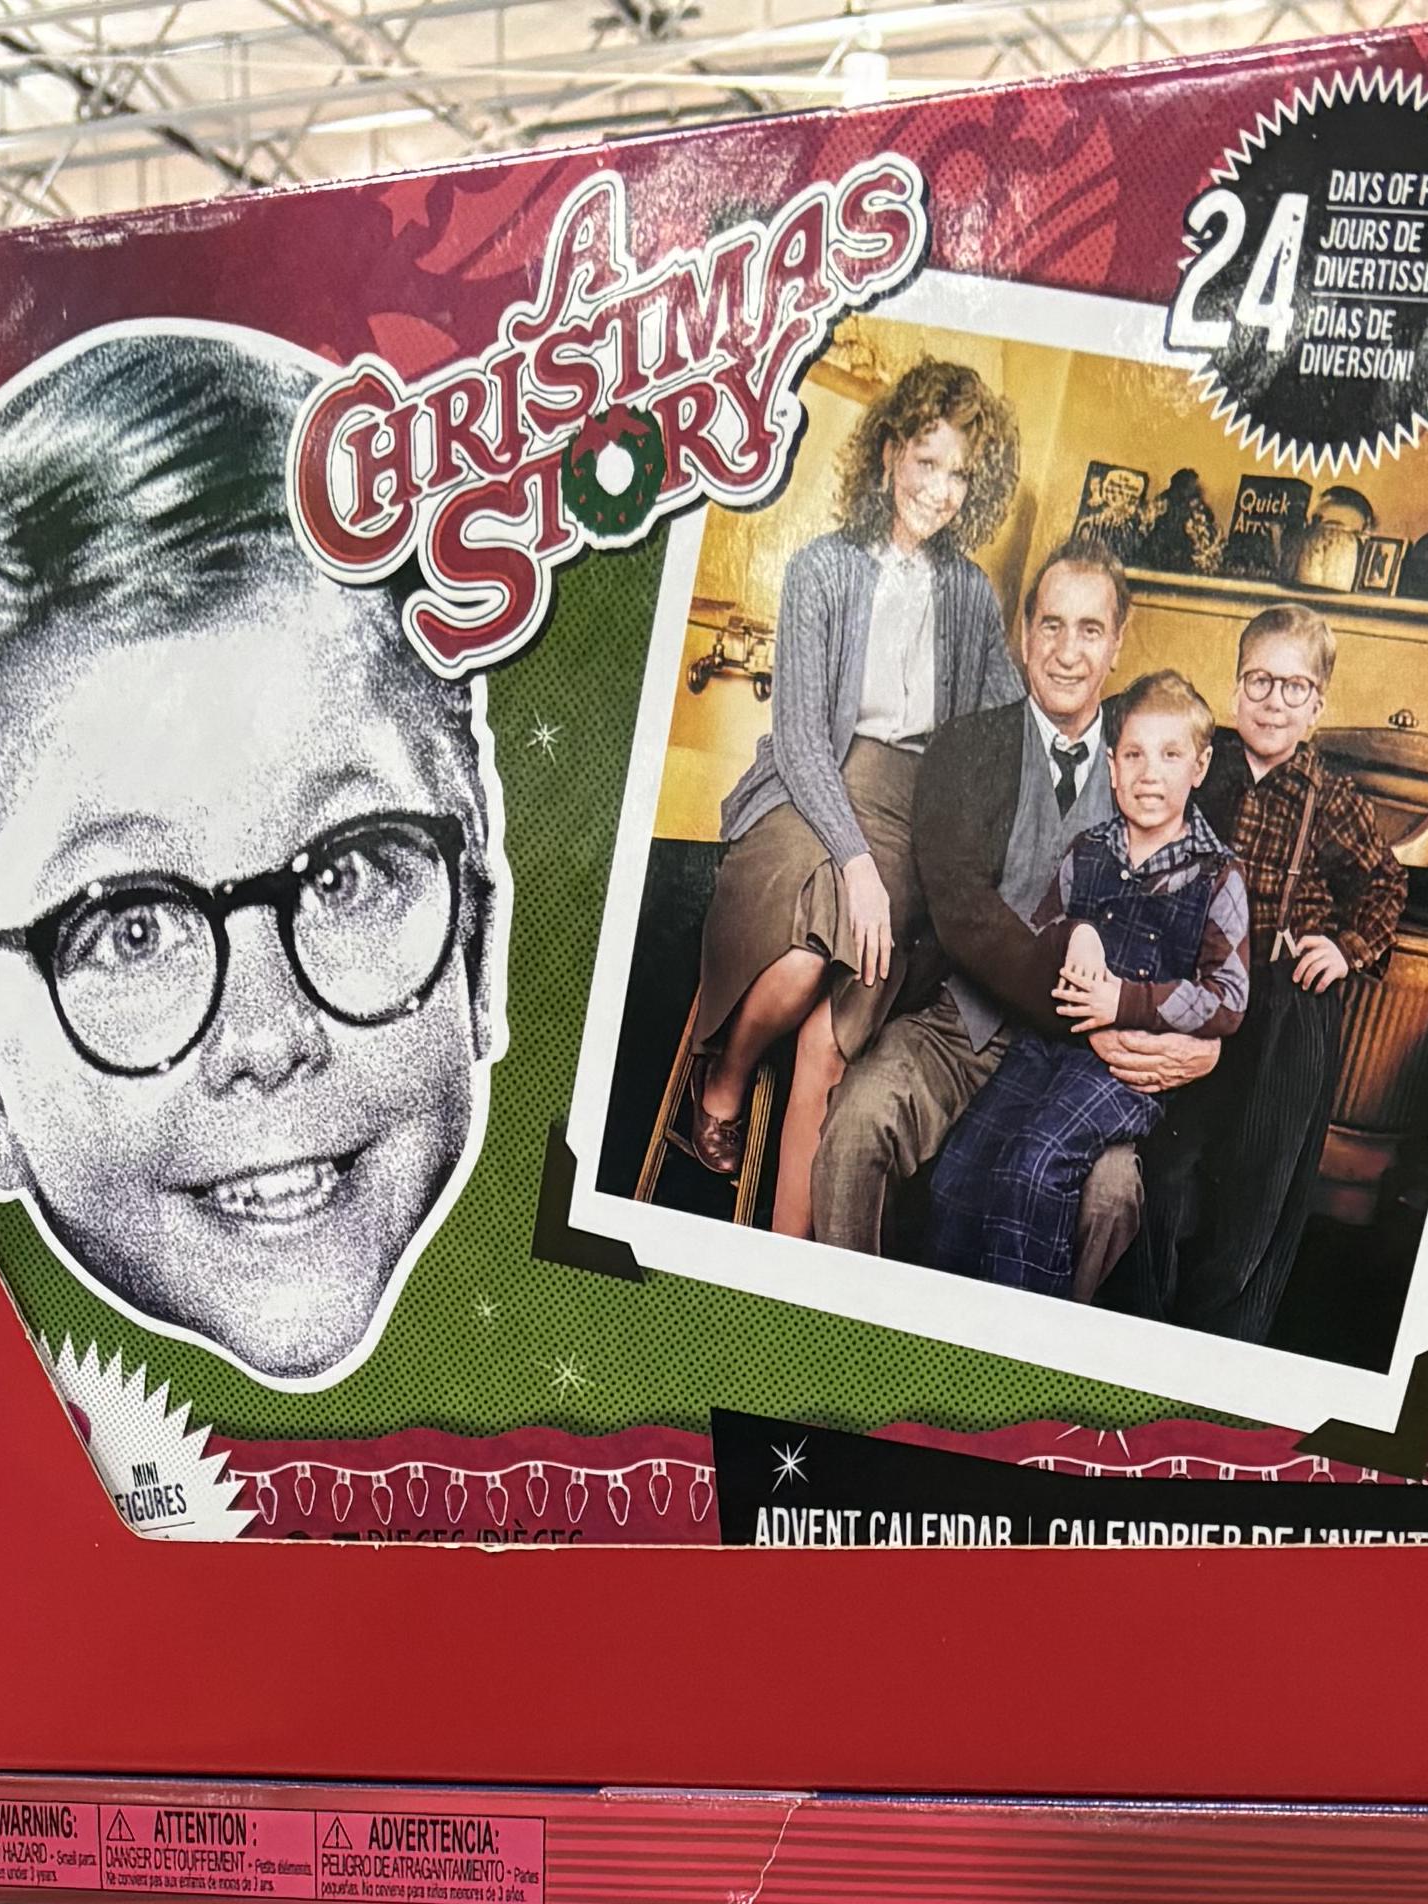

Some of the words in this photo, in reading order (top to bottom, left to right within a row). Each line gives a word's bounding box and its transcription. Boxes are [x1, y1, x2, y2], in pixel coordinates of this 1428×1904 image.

[1329, 170, 1383, 205] DAYS
[1388, 173, 1415, 206] OF
[1320, 218, 1390, 251] JOURS
[1394, 222, 1425, 253] DE
[515, 193, 627, 340] A
[1169, 189, 1308, 350] 24
[1366, 310, 1397, 341] DE
[296, 168, 910, 563] CHRISTMAS
[1299, 343, 1415, 381] DIVERSIÓN!
[416, 322, 812, 655] STORY
[132, 1461, 158, 1486] MINI
[369, 1817, 499, 1853] ADVERTENCIA:
